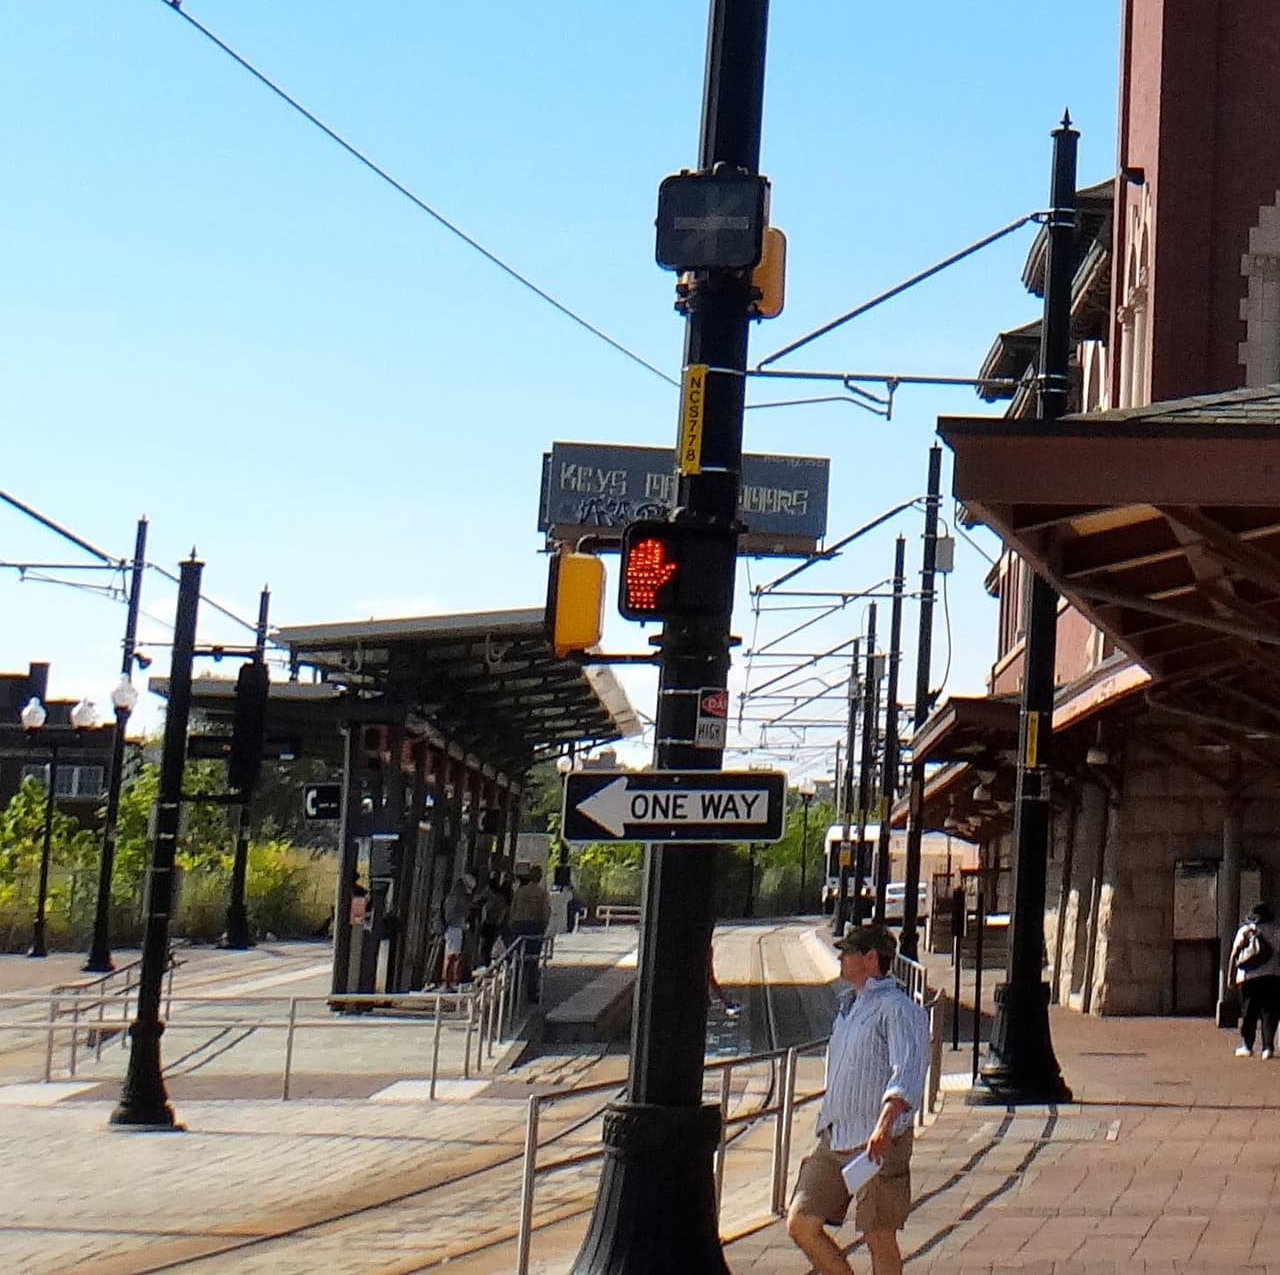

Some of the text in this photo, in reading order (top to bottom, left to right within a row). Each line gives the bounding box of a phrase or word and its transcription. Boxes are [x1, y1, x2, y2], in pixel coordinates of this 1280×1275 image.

[686, 376, 701, 462] NCS778
[631, 794, 760, 820] ONE WAY
